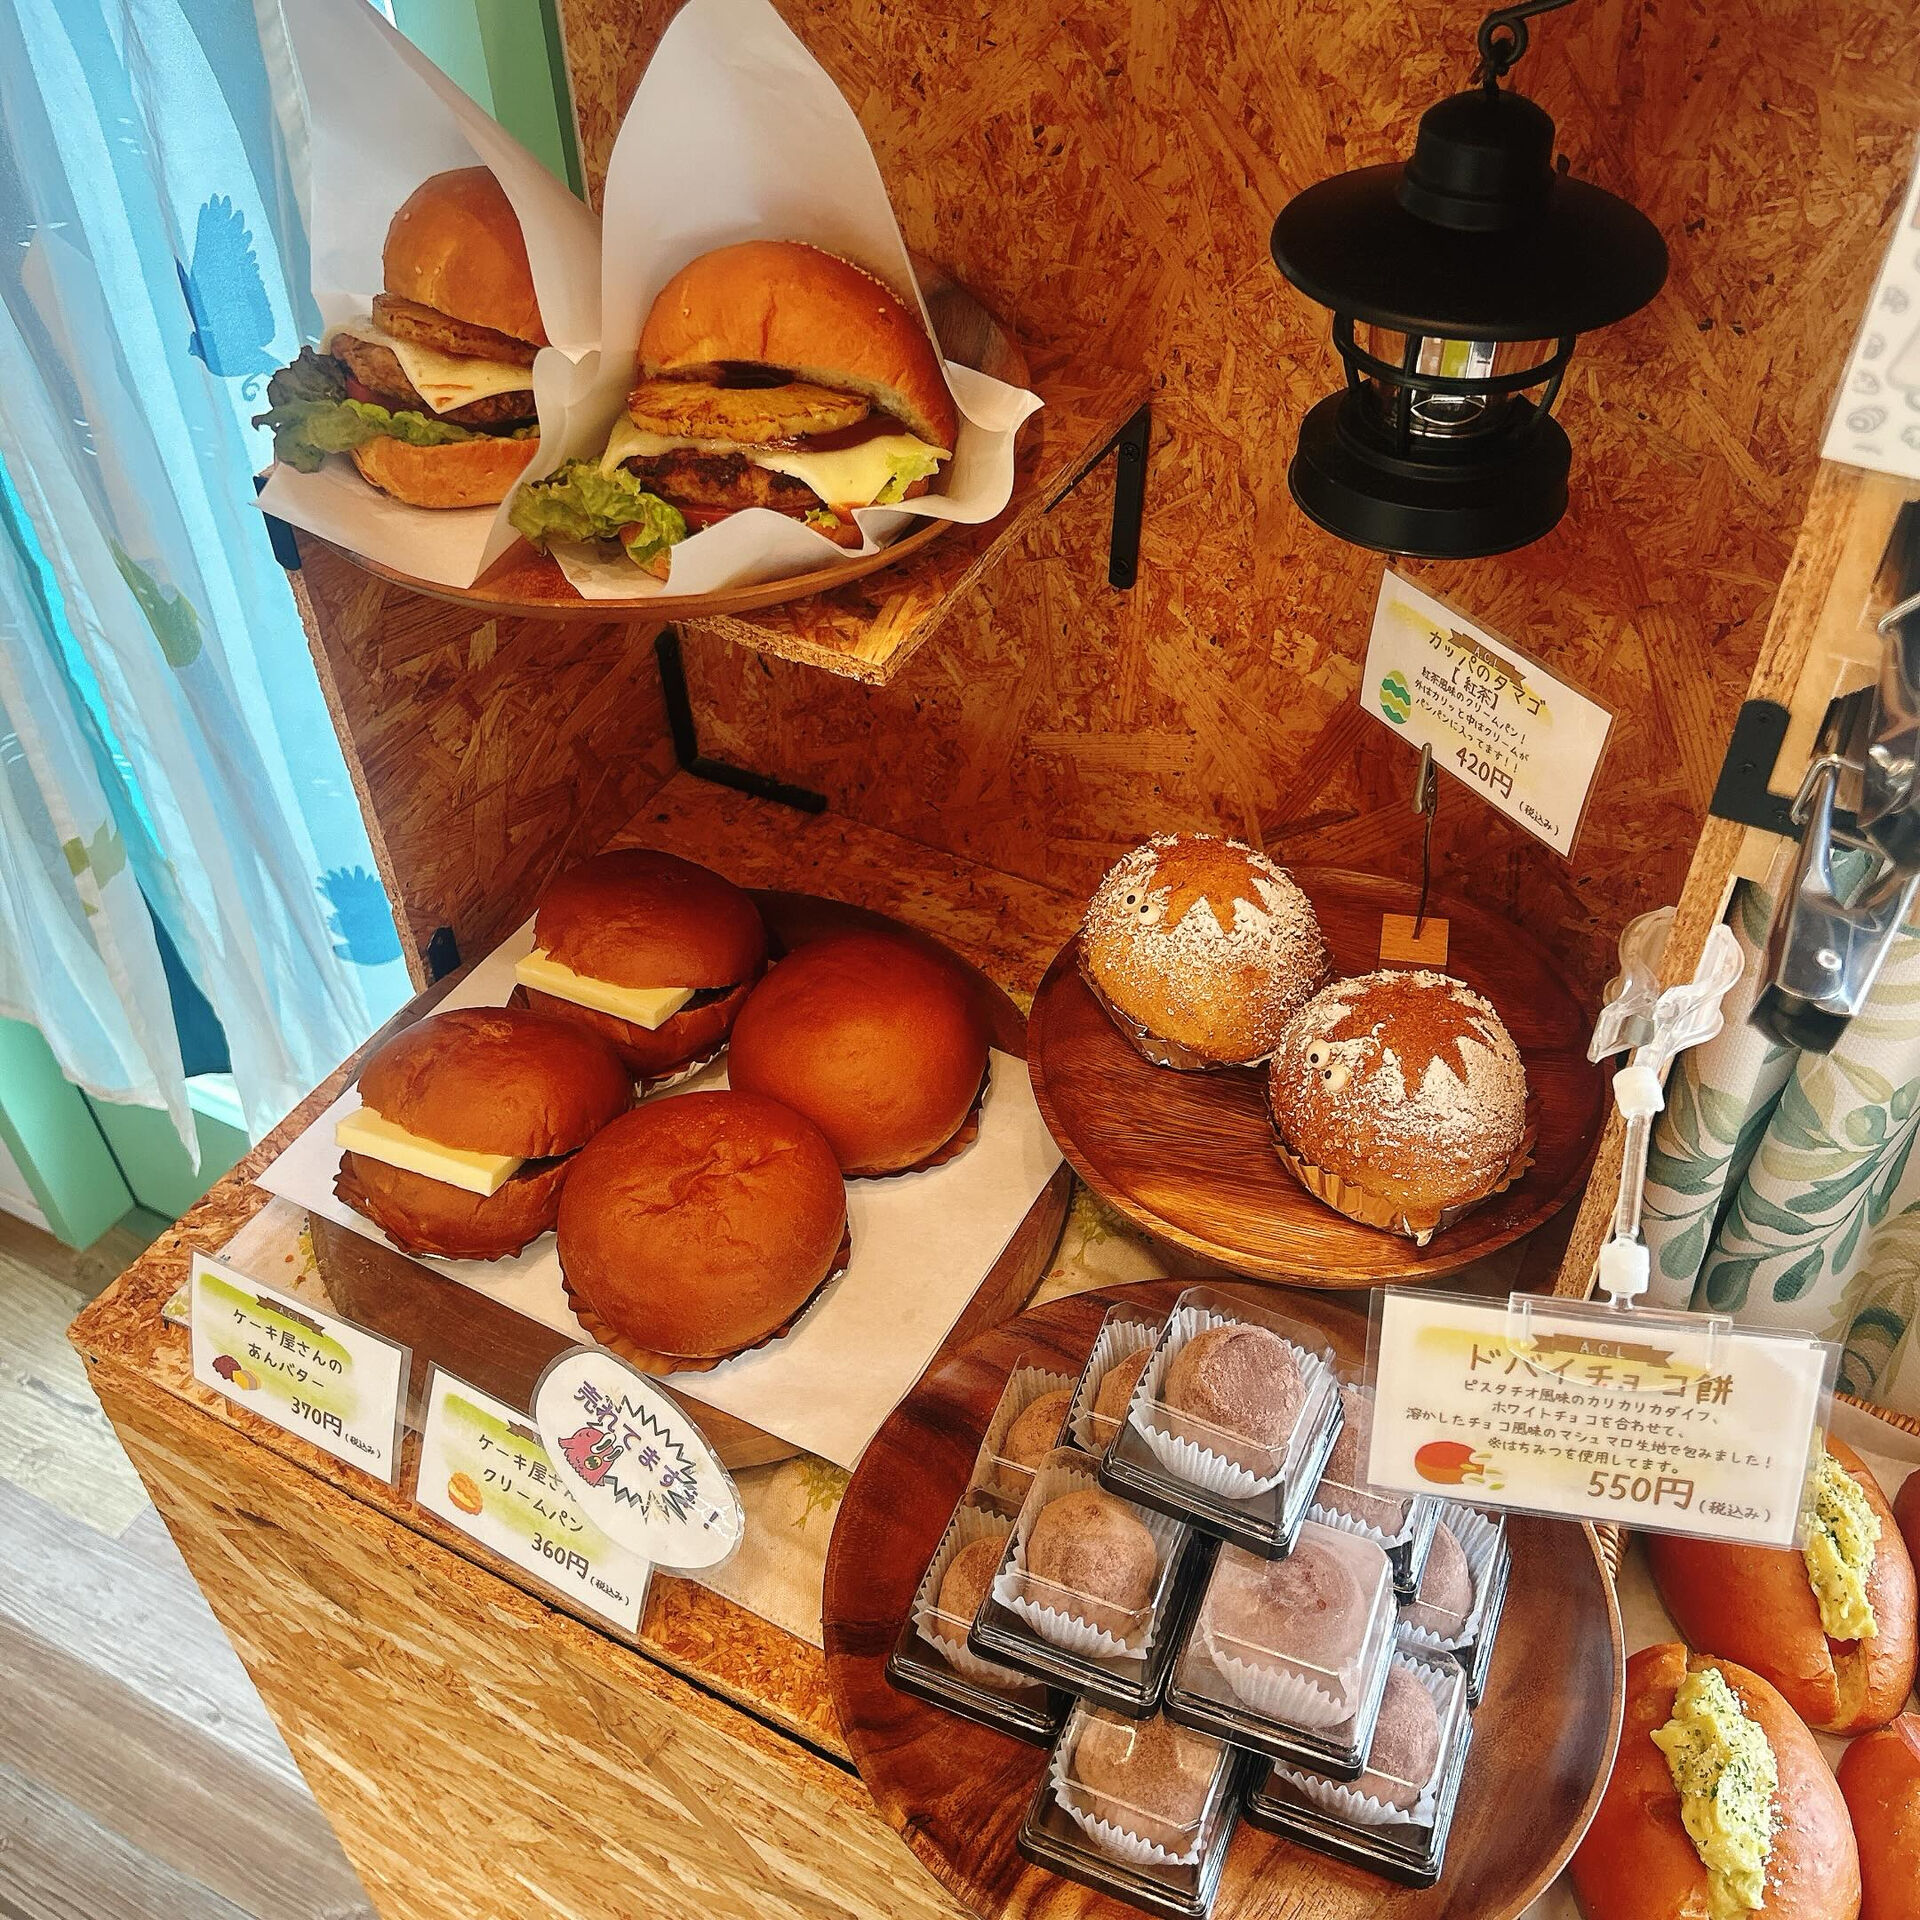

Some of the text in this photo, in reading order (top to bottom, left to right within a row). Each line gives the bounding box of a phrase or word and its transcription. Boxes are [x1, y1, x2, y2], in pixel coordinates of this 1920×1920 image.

[1429, 631, 1546, 716] カッパのタマゴ
[1414, 679, 1530, 762] 外はカリッと中はクリームが
[1455, 747, 1514, 800] 420円
[233, 1308, 343, 1375] ケーキ屋さんの
[247, 1342, 325, 1389] あんバター
[1470, 1343, 1734, 1406] ドバイチョコ餅
[290, 1396, 343, 1438] 370円
[483, 1467, 584, 1533] クリームパン
[1587, 1471, 1694, 1511] 550円
[531, 1532, 589, 1580] 360円
